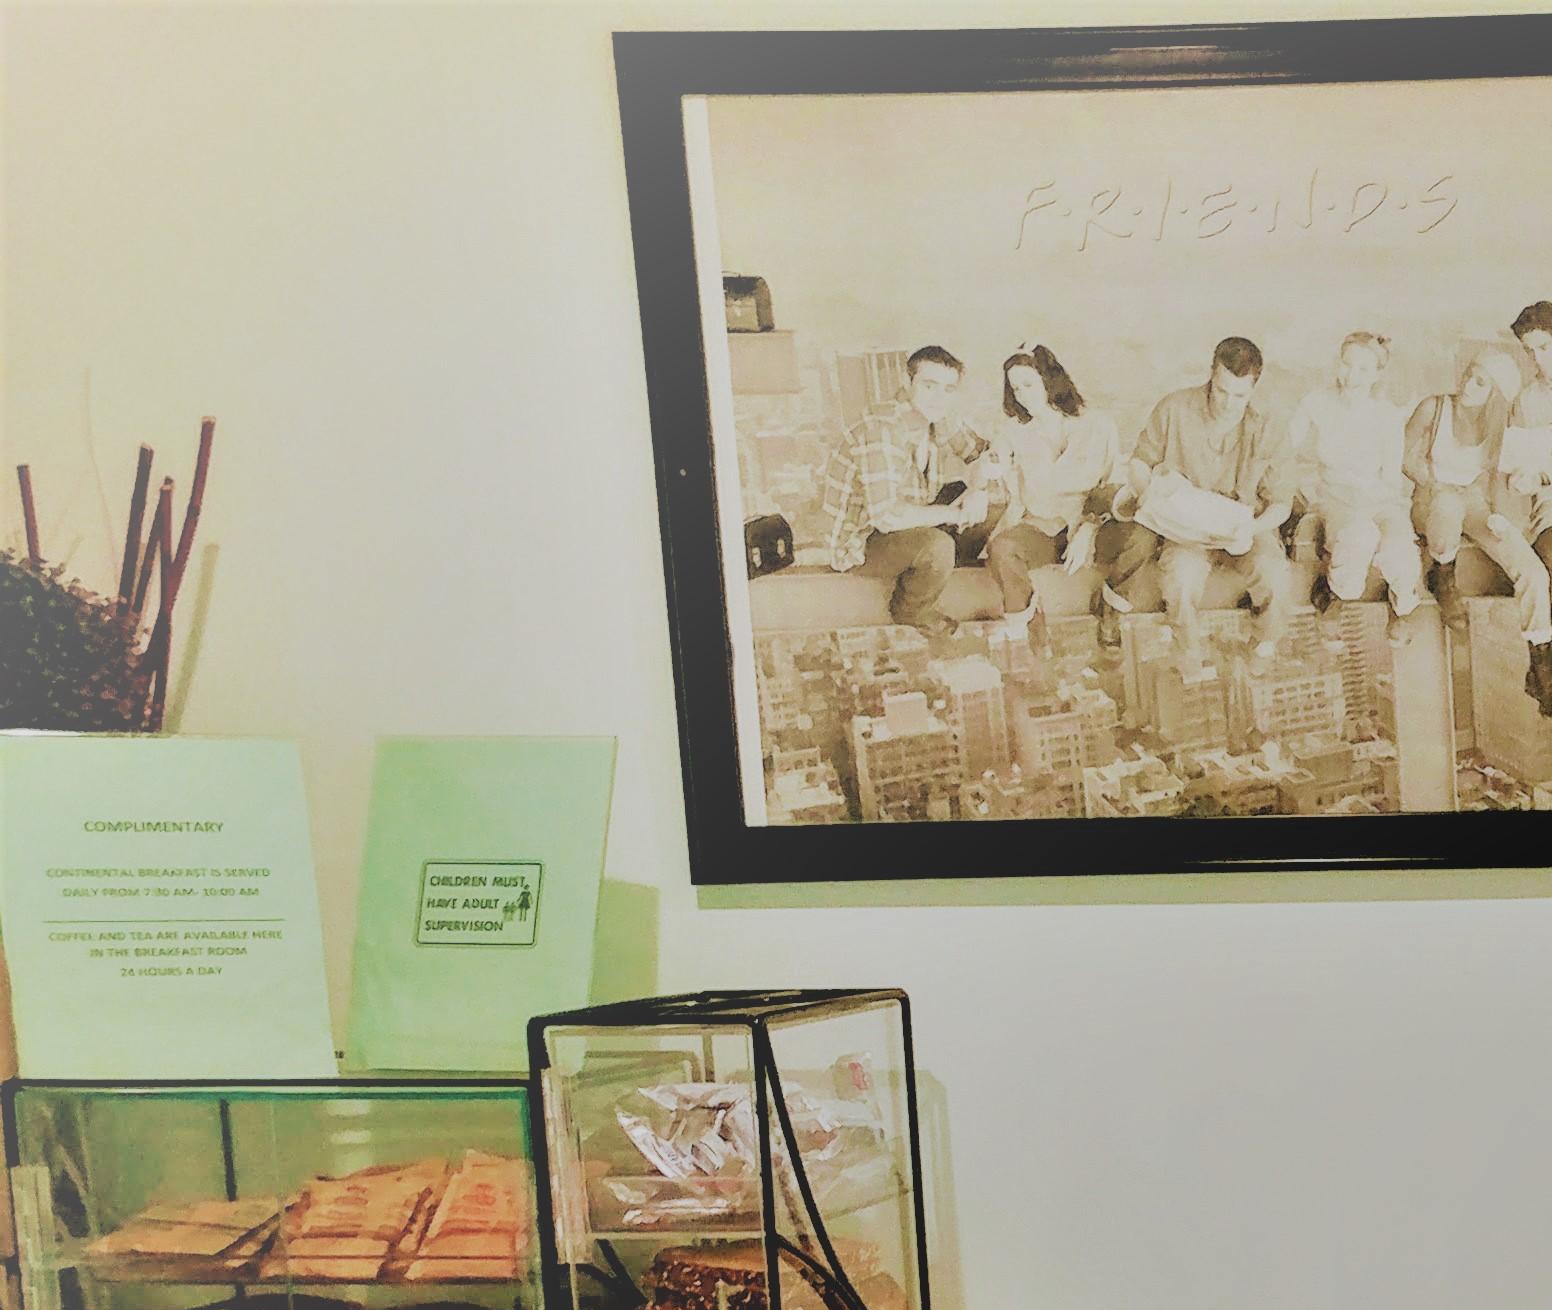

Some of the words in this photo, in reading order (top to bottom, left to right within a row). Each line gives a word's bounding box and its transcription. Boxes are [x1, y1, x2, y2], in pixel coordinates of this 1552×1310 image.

[84, 821, 224, 833] COMPLIMENTARY
[223, 867, 271, 878] SERVED
[430, 875, 487, 887] CHILDREN
[427, 898, 458, 909] HAVE
[462, 898, 500, 909] ADULT
[424, 920, 504, 932] SUPERVISION
[99, 931, 126, 941] AND
